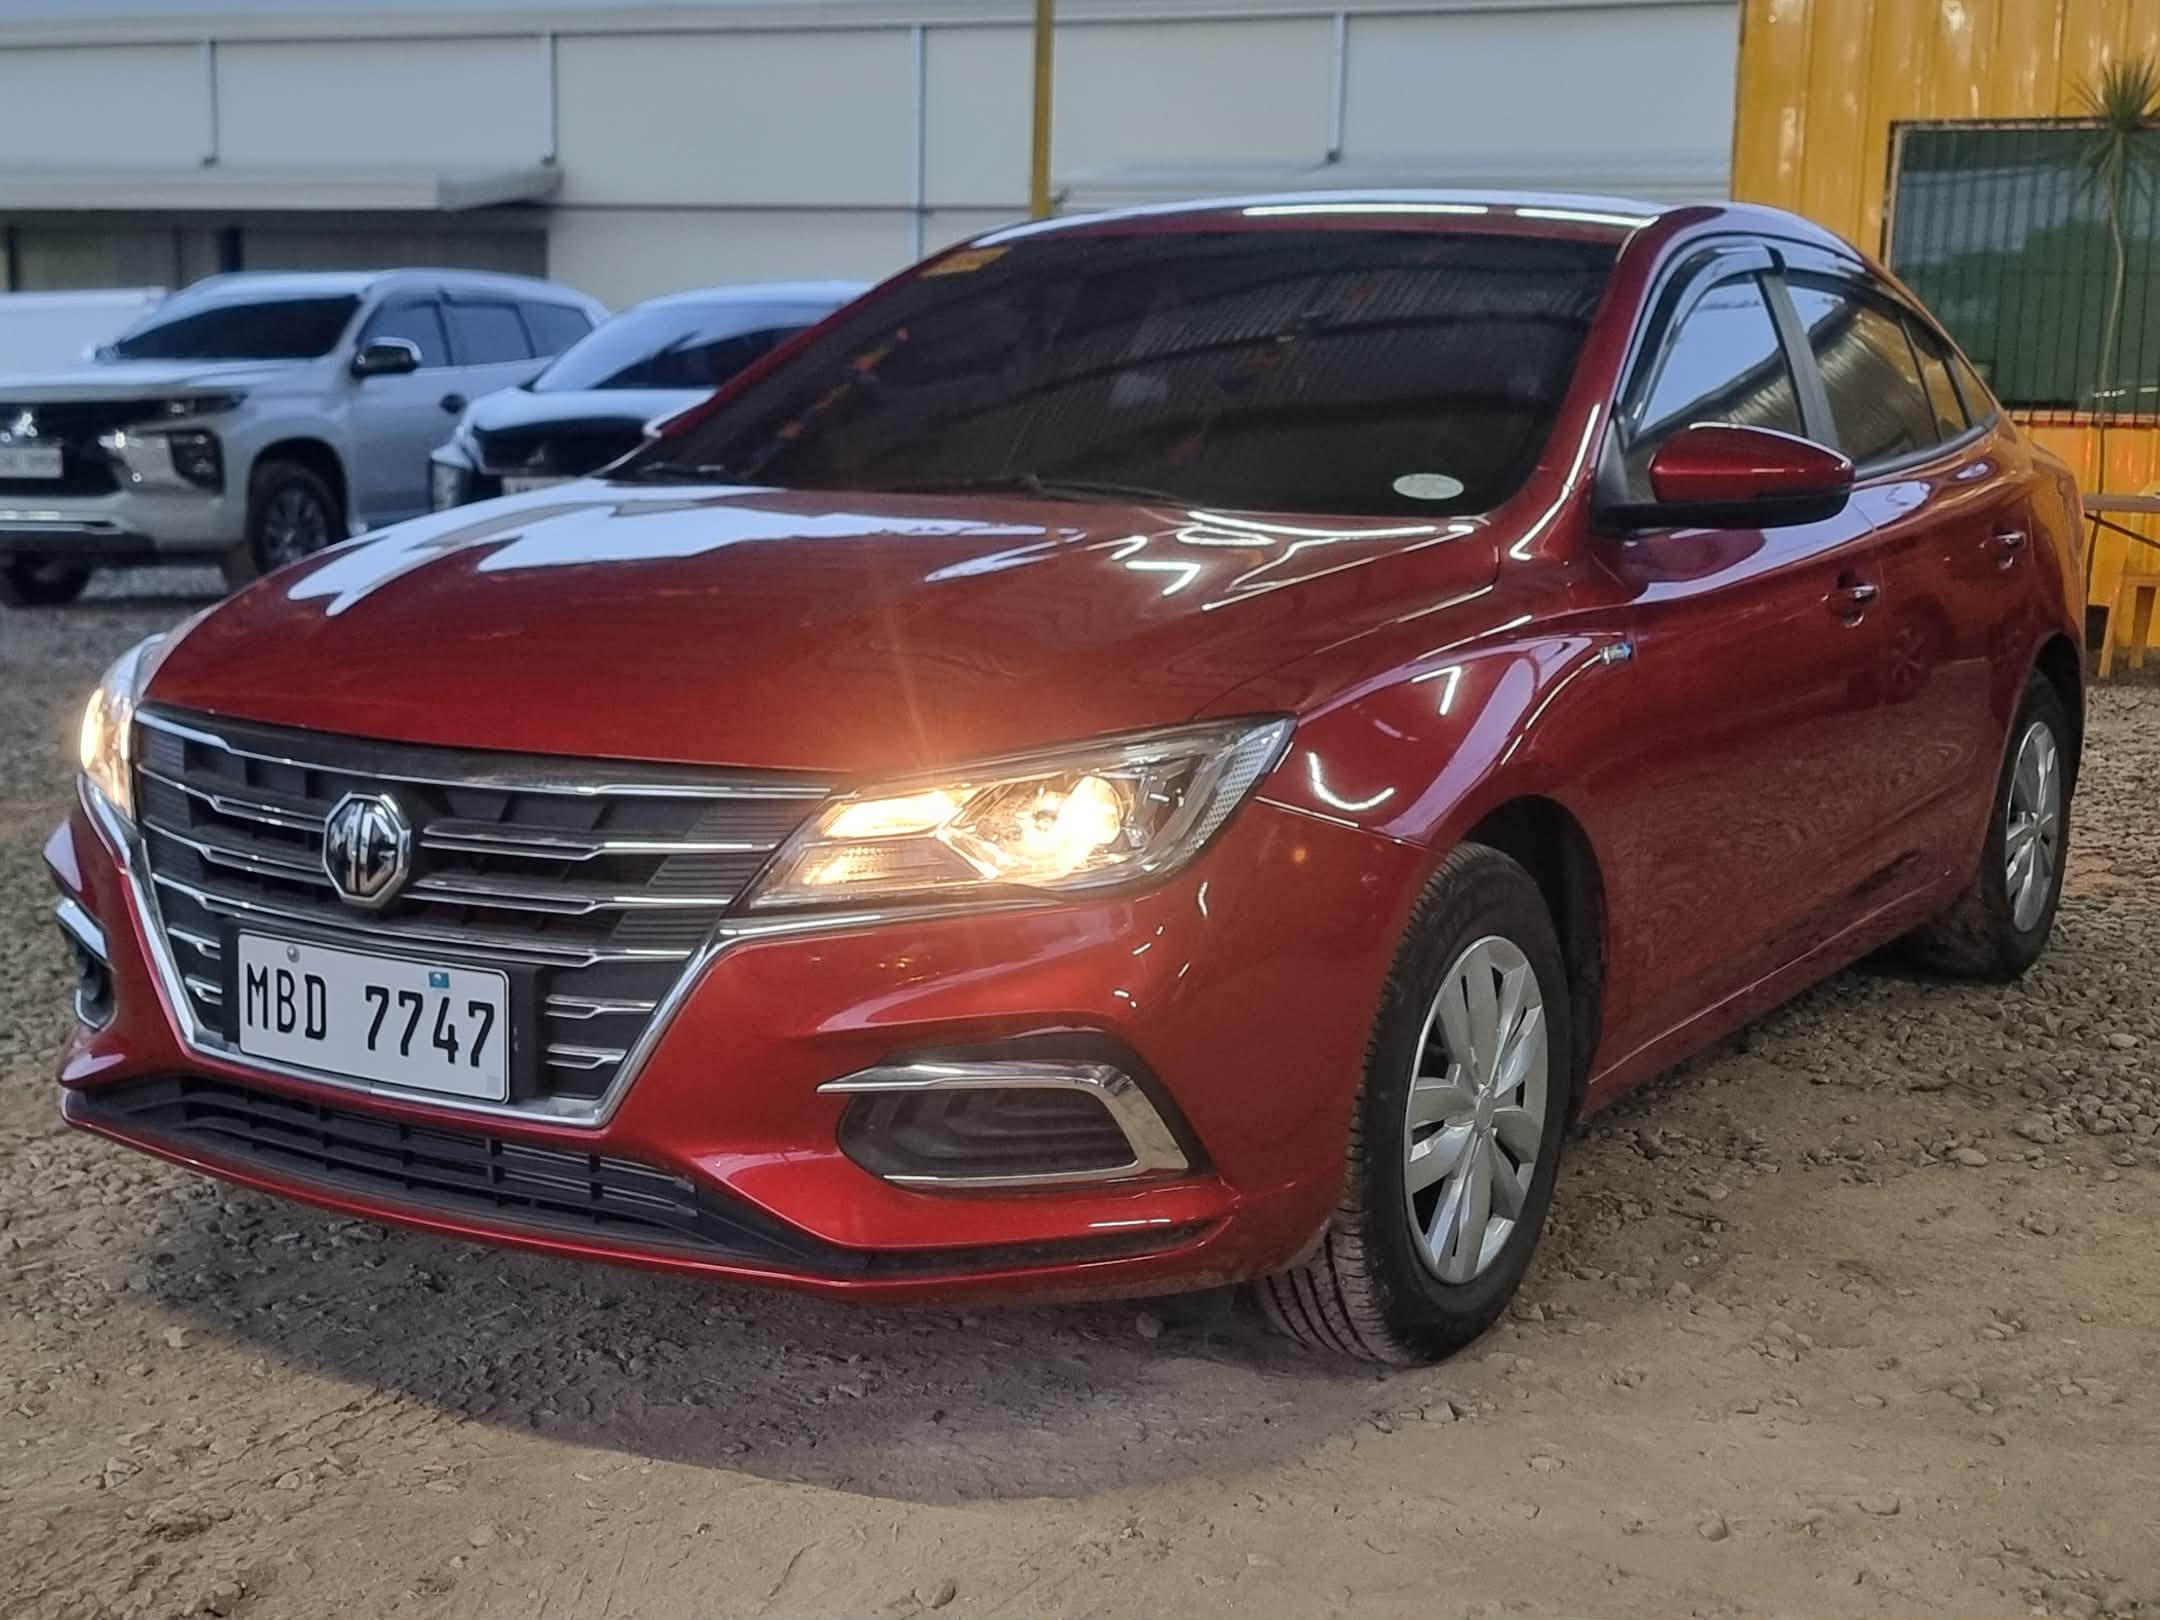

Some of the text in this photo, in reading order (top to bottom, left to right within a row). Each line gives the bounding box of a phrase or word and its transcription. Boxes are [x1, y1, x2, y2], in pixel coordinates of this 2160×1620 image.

[326, 798, 399, 893] MG
[246, 962, 495, 1068] MBD 7747
